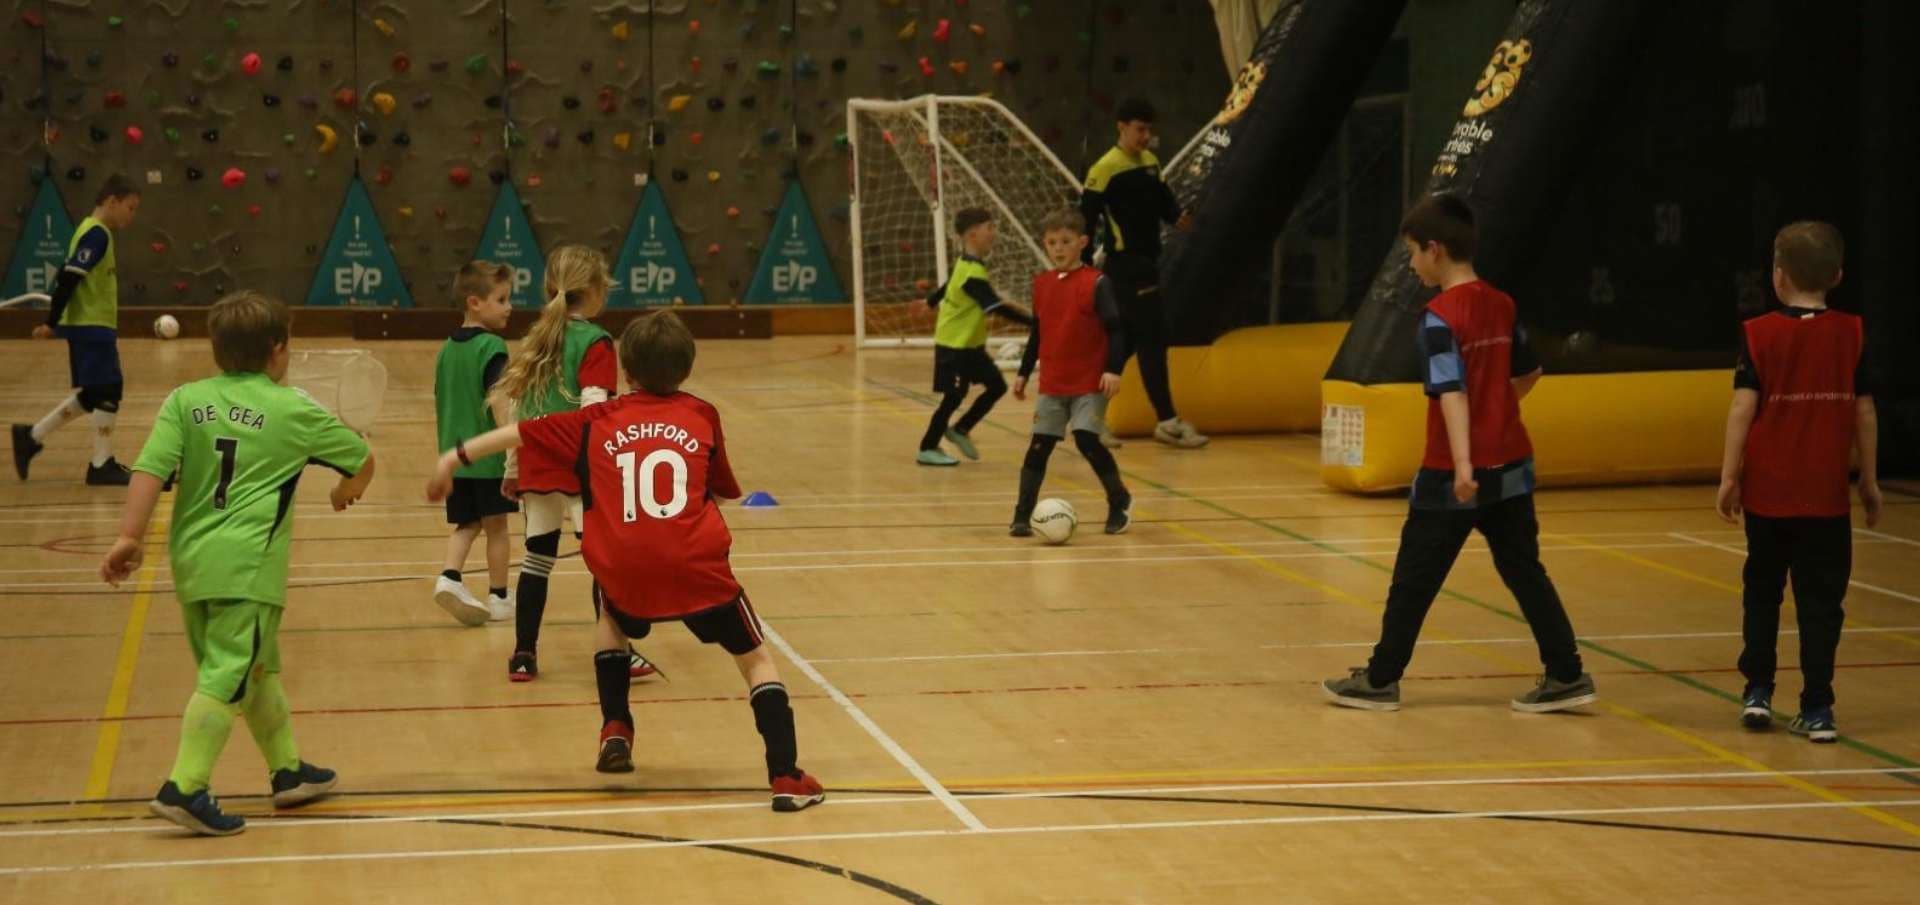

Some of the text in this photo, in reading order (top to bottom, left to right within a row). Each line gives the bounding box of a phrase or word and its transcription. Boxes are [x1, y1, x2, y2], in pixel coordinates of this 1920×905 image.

[192, 405, 265, 430] DE GEA
[603, 423, 699, 456] RASHFORD
[214, 437, 238, 511] 1
[616, 448, 688, 523] 10
